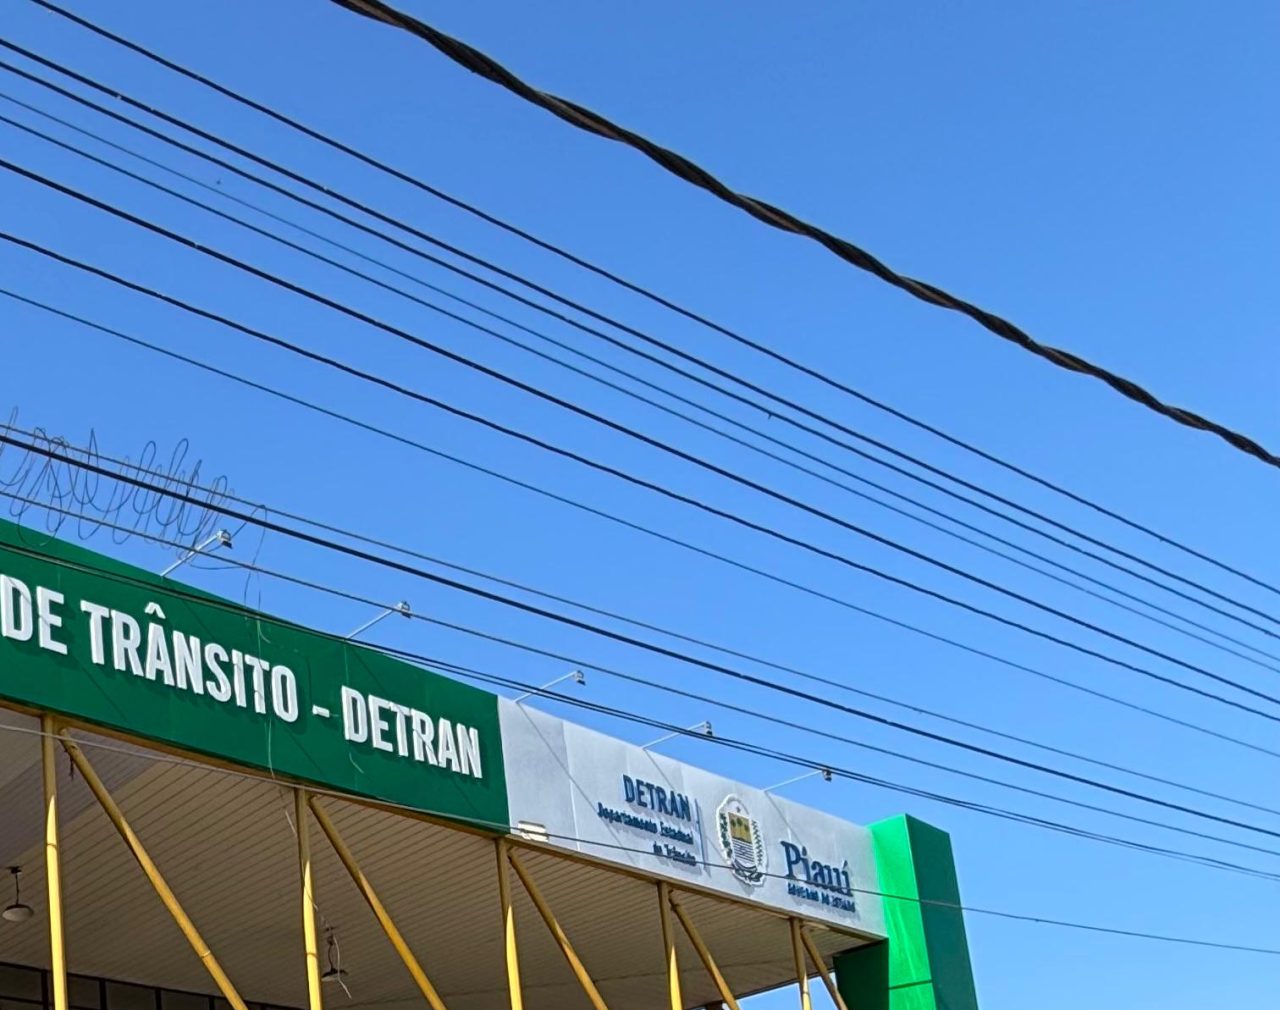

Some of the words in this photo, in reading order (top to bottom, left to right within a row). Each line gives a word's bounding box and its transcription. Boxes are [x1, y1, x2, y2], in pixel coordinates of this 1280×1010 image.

[80, 600, 299, 723] TRÂNSITO
[312, 705, 330, 718] -
[341, 685, 483, 779] DETRAN
[623, 774, 691, 822] DETRAN
[780, 841, 854, 897] Piauí
